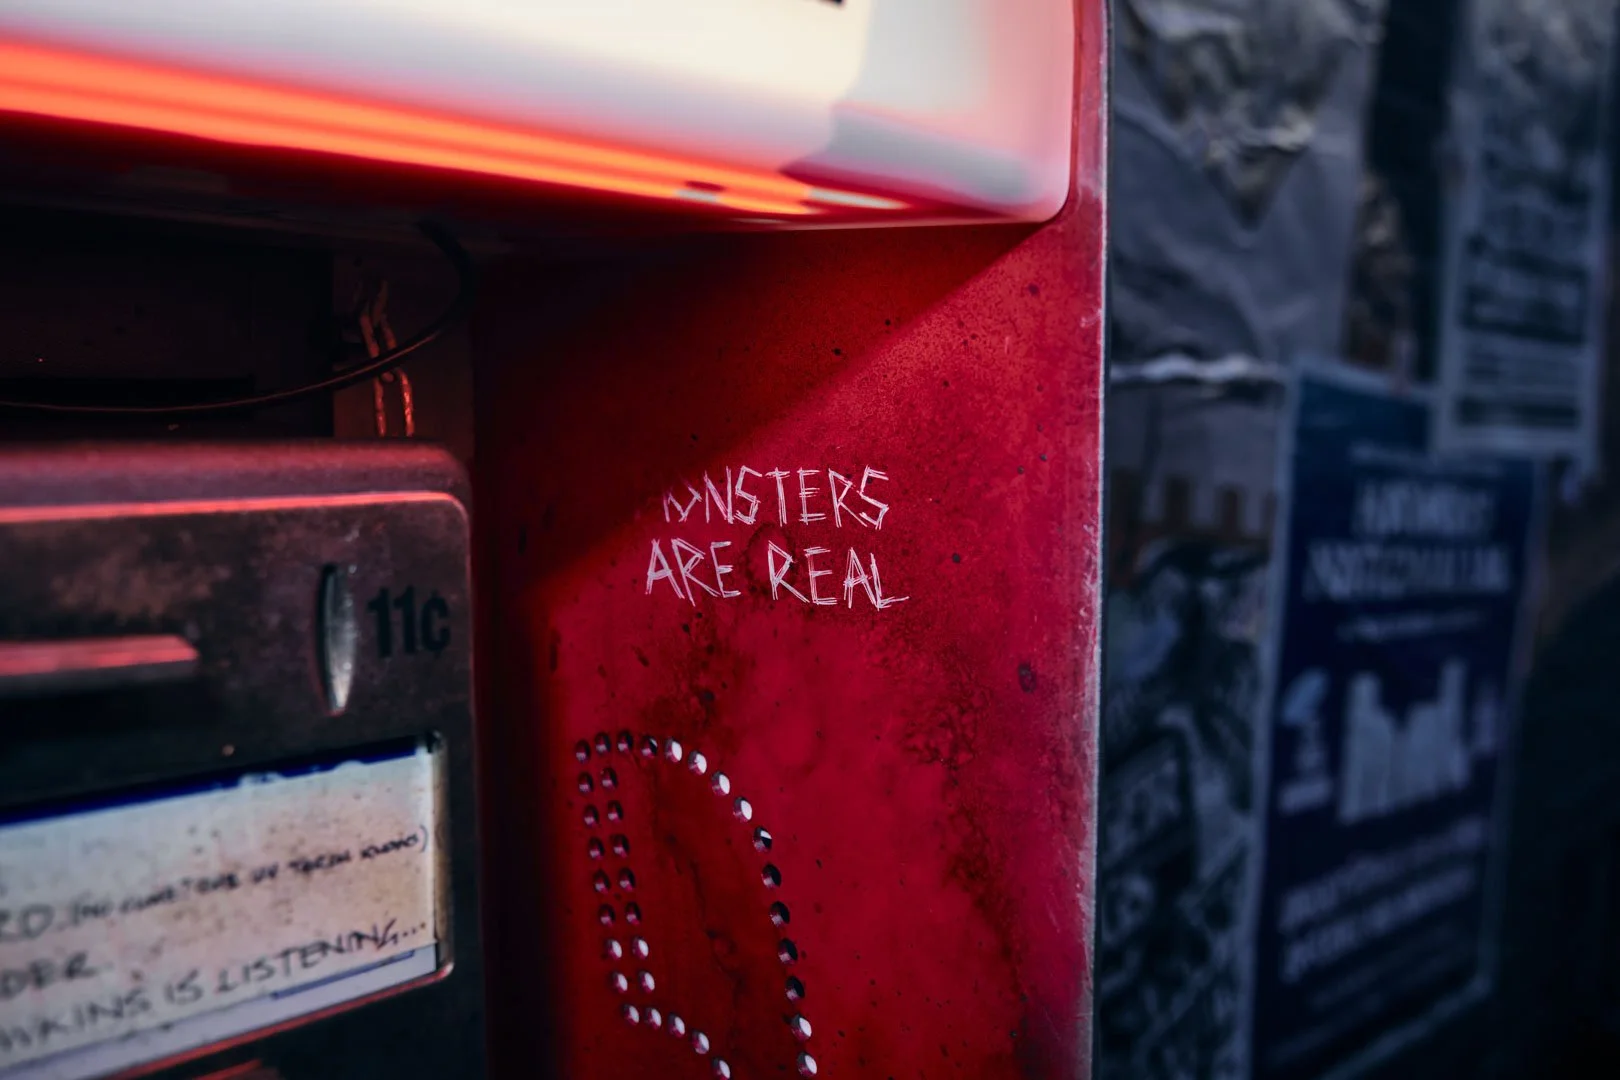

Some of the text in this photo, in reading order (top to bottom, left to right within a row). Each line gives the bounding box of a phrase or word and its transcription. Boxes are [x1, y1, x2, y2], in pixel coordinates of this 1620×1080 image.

[645, 538, 910, 611] ARE REAL
[164, 967, 205, 1006] IS
